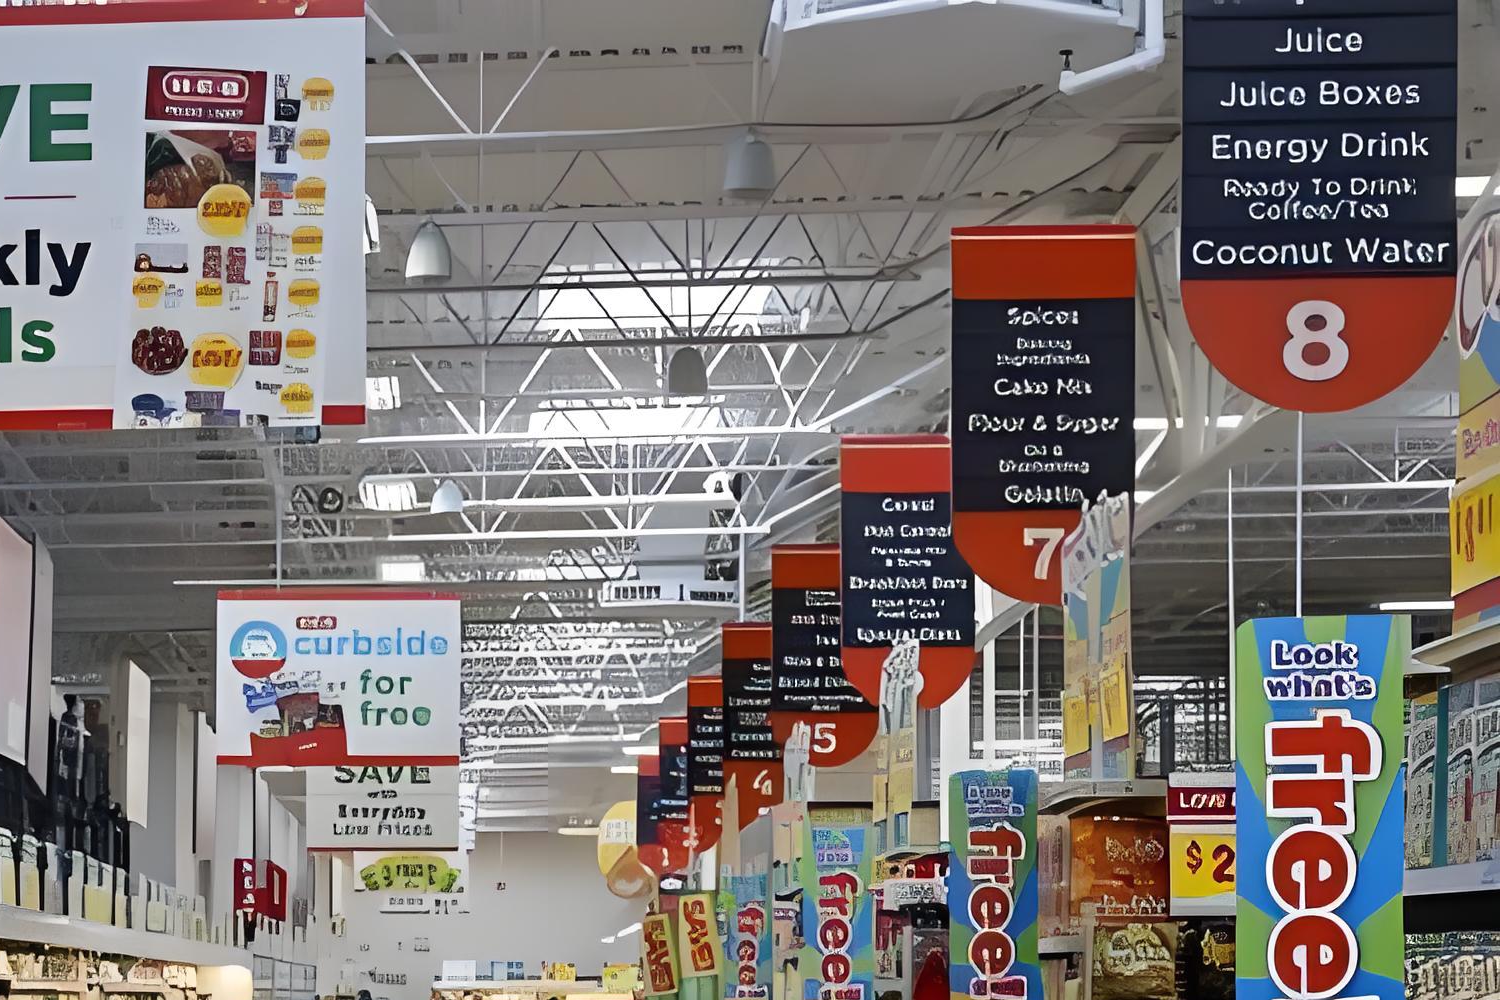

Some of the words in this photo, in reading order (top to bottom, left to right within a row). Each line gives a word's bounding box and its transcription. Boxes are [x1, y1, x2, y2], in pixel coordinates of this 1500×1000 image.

[1274, 27, 1363, 53] Juice
[1220, 80, 1306, 107] Juice
[1319, 80, 1421, 106] Boxes
[1211, 133, 1329, 163] Energy
[1341, 131, 1429, 158] Drink
[1223, 178, 1300, 201] Ready
[1312, 177, 1341, 197] To
[1350, 177, 1417, 197] Drink
[1192, 239, 1333, 266] Coconut
[1345, 238, 1450, 264] Water
[1282, 299, 1350, 382] 8
[1022, 527, 1066, 580] 7
[294, 627, 449, 657] curbside
[1274, 642, 1359, 667] Look
[359, 668, 413, 695] for
[967, 825, 1028, 1000] free!
